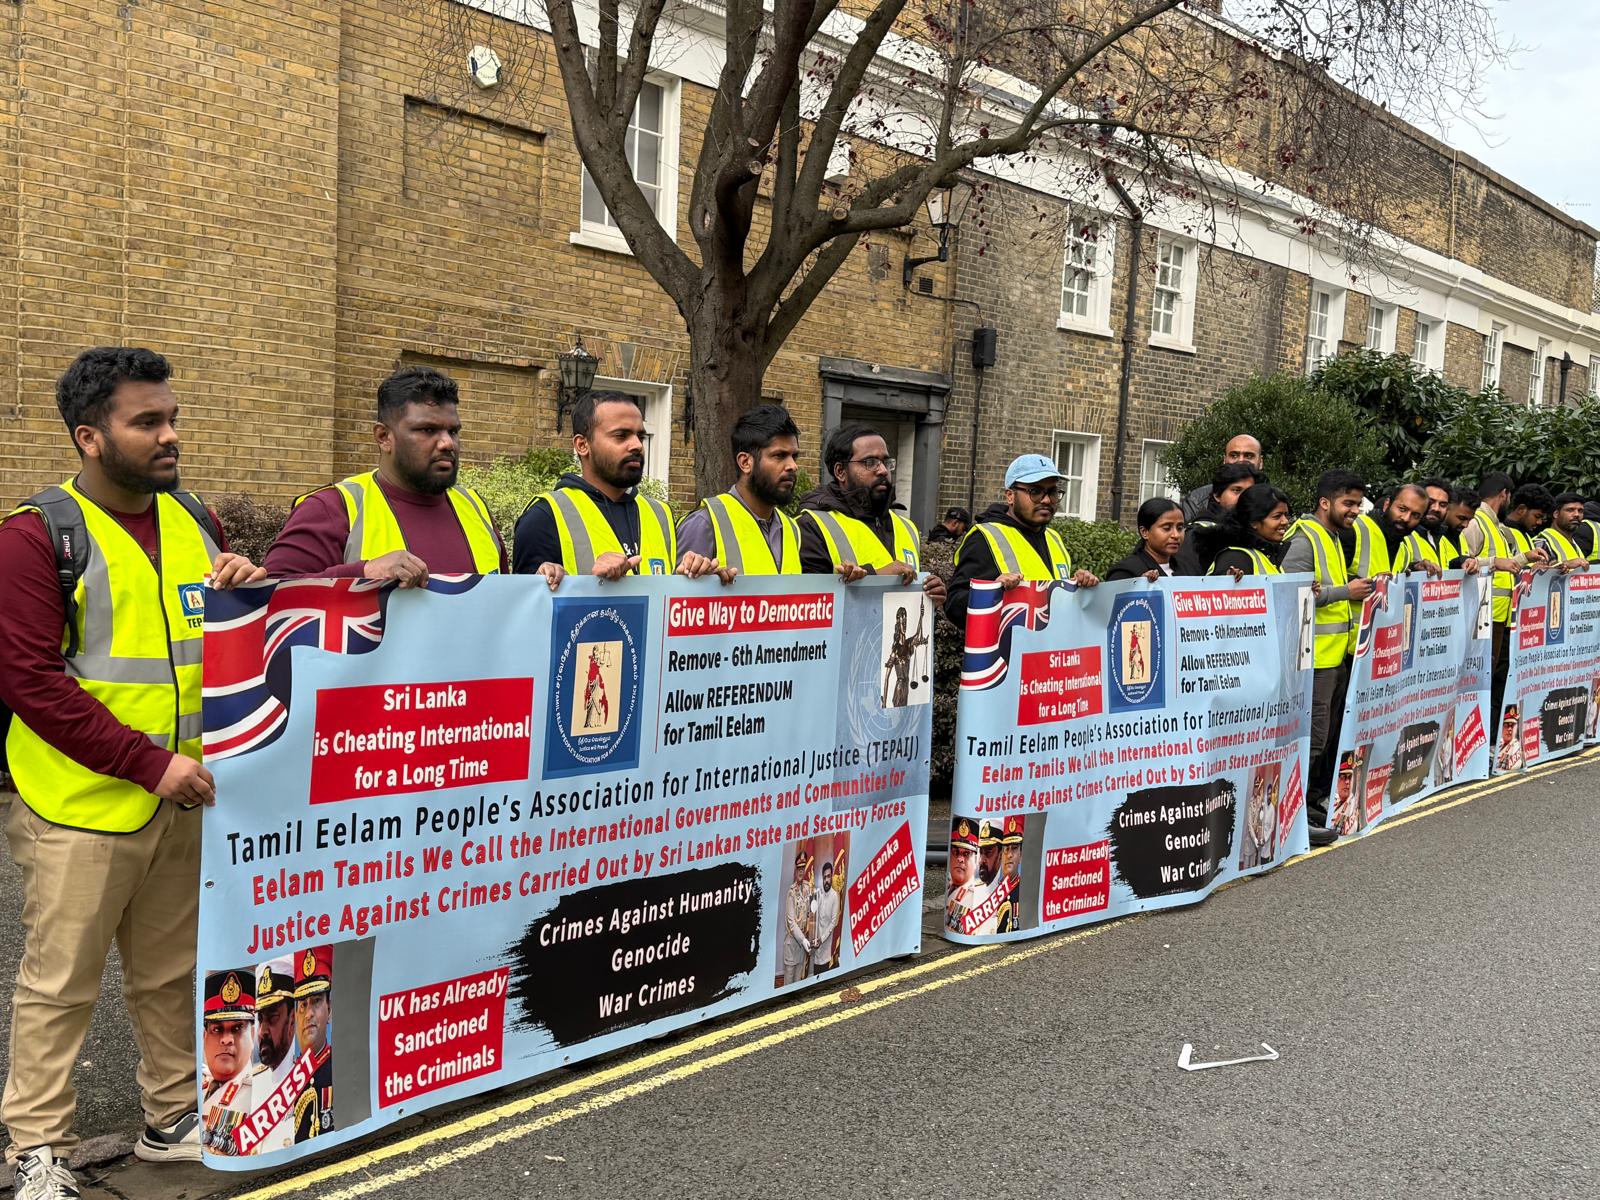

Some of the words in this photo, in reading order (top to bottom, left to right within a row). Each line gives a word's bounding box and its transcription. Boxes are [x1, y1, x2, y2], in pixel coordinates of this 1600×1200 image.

[669, 598, 705, 628] Give
[708, 602, 737, 630] Way
[740, 605, 756, 624] to
[759, 598, 833, 623] Democratic
[1176, 594, 1193, 612] Give
[1193, 595, 1210, 613] Way
[1212, 596, 1222, 610] to
[1223, 592, 1266, 610] Democratic
[187, 617, 203, 629] TEP
[1180, 627, 1208, 642] Remove
[1215, 625, 1225, 638] 6th
[1226, 623, 1266, 638] Amendment
[668, 650, 721, 672] Remove
[732, 647, 752, 667] 6th
[754, 641, 827, 665] Amendment
[1049, 654, 1061, 668] Sri
[1062, 652, 1081, 667] Lanka
[1180, 655, 1205, 672] Allow
[1206, 651, 1250, 669] REFERENDUM
[383, 687, 410, 712] Sri
[415, 684, 467, 710] Lanka
[665, 690, 704, 714] Allow
[707, 680, 793, 709] REFERENDUM
[1020, 683, 1028, 696] is
[1030, 678, 1063, 697] Cheating
[1065, 671, 1101, 691] International
[1180, 678, 1196, 694] for
[1197, 674, 1219, 691] Tamil
[1219, 674, 1241, 689] Eelam
[556, 712, 564, 735] EELAM
[600, 751, 609, 761] FOR
[608, 713, 632, 756] INTERNATIONAL
[630, 684, 638, 712] JUSTICE
[1038, 704, 1049, 718] for
[1058, 702, 1077, 718] Long
[1078, 699, 1089, 713] Time
[313, 735, 329, 757] is
[333, 725, 415, 757] Cheating
[420, 715, 531, 748] International
[663, 725, 682, 746] for
[686, 718, 722, 743] Tamil
[726, 714, 765, 737] Eelam
[966, 733, 1013, 757] Tamil
[1019, 729, 1058, 754] Eelam
[1104, 712, 1178, 745] Association
[1183, 711, 1203, 731] for
[1208, 702, 1264, 729] International
[1265, 698, 1289, 722] Justice
[354, 767, 380, 791] for
[386, 771, 397, 787] a
[402, 762, 445, 790] Long
[449, 757, 488, 781] Time
[981, 764, 1023, 784] Eelam
[1028, 762, 1065, 780] Tamils
[1068, 757, 1082, 773] We
[1083, 755, 1097, 771] Call
[1099, 751, 1114, 767] the
[1117, 743, 1193, 763] International
[1197, 730, 1245, 753] Governments
[1247, 727, 1260, 743] and
[975, 794, 1024, 812] Justice
[1028, 789, 1073, 811] Against
[1075, 780, 1103, 799] Crimes
[1105, 772, 1143, 794] Carried
[1146, 769, 1166, 785] Out
[1170, 767, 1185, 785] by
[1189, 763, 1205, 780] Sri
[1229, 753, 1248, 769] State
[1250, 749, 1264, 766] and
[1264, 744, 1289, 763] Security
[227, 820, 302, 865] Tamil
[316, 812, 401, 850] Eelam
[530, 777, 654, 819] Association
[662, 771, 689, 798] for
[694, 751, 806, 793] International
[811, 742, 860, 779] Justice
[866, 735, 920, 772] (TEPAIJ)
[1119, 808, 1156, 828] Crimes
[1160, 802, 1204, 824] Against
[1205, 791, 1231, 814] Humanity
[252, 869, 324, 906] Eelam
[334, 852, 415, 890] Tamils
[423, 846, 452, 875] We
[461, 834, 503, 866] Call
[511, 830, 542, 858] the
[549, 808, 670, 853] International
[675, 789, 772, 830] Governments
[776, 787, 801, 810] and
[804, 769, 887, 803] Communities
[889, 768, 905, 787] for
[1046, 851, 1060, 867] UK
[1061, 849, 1078, 865] has
[1079, 840, 1110, 864] Already
[1165, 829, 1211, 850] Genocide
[247, 911, 331, 954] Justice
[339, 895, 431, 936] Against
[438, 879, 512, 914] Crimes
[519, 861, 590, 899] Carried
[596, 855, 628, 881] Out
[633, 852, 655, 878] by
[659, 845, 682, 868] Sri
[687, 835, 741, 863] Lankan
[746, 827, 782, 849] State
[786, 821, 809, 841] and
[812, 810, 867, 837] Security
[870, 801, 906, 824] Forces
[856, 869, 873, 896] Sri
[870, 836, 900, 879] Lanka
[1052, 870, 1103, 891] Sanctioned
[1160, 864, 1184, 883] War
[850, 893, 877, 932] Don't
[876, 850, 913, 897] Honour
[963, 877, 1013, 933] ARREST
[1045, 901, 1061, 917] the
[1062, 892, 1105, 915] Criminals
[540, 913, 603, 947] Crimes
[609, 900, 674, 935] Against
[679, 878, 754, 916] Humanity
[853, 929, 873, 956] the
[870, 876, 919, 933] Criminals
[611, 933, 690, 973] Genocide
[380, 997, 405, 1022] UK
[409, 992, 439, 1015] has
[442, 972, 508, 1006] Already
[599, 991, 633, 1019] War
[638, 974, 695, 1008] Crimes
[394, 1008, 488, 1056] Sanctioned
[385, 1072, 412, 1098] the
[416, 1046, 495, 1087] Criminals
[237, 1048, 319, 1152] ARREST
